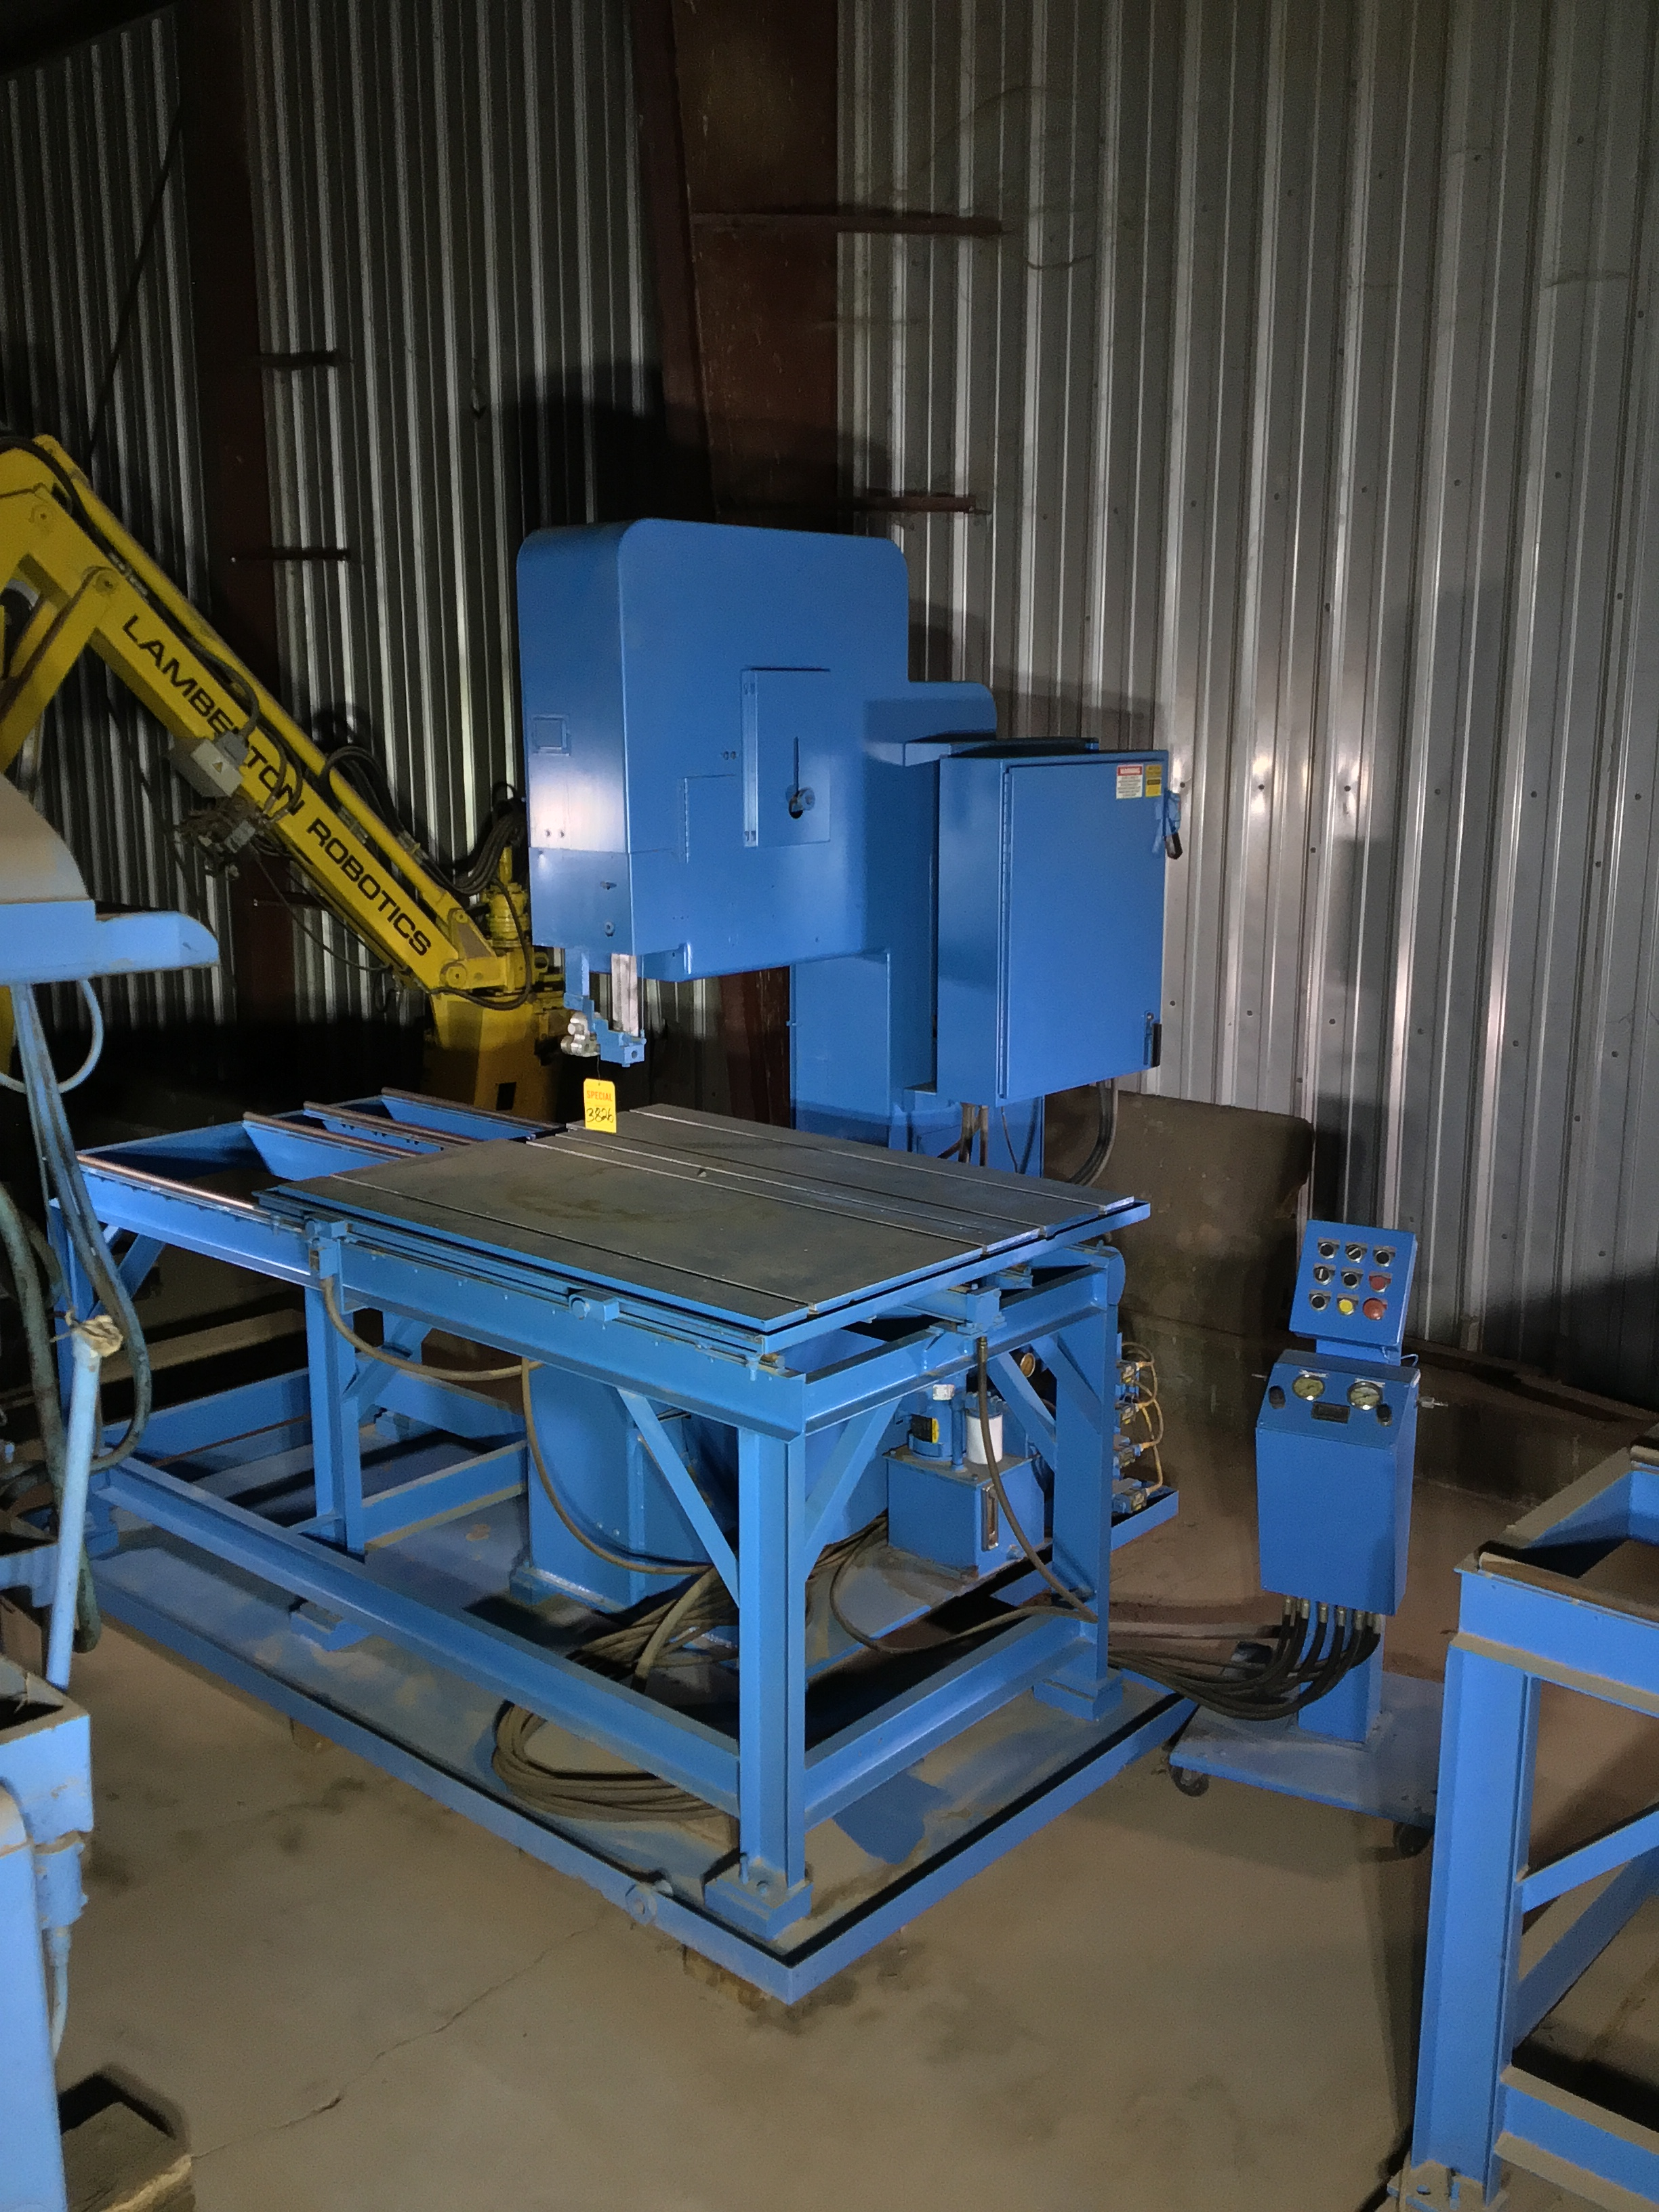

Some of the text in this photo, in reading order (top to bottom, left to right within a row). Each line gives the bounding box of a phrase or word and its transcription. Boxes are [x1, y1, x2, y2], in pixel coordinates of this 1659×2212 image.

[123, 615, 432, 957] LAMBETON ROBOTICS
[587, 1090, 613, 1101] SPECIAL
[586, 1107, 614, 1123] 3826
